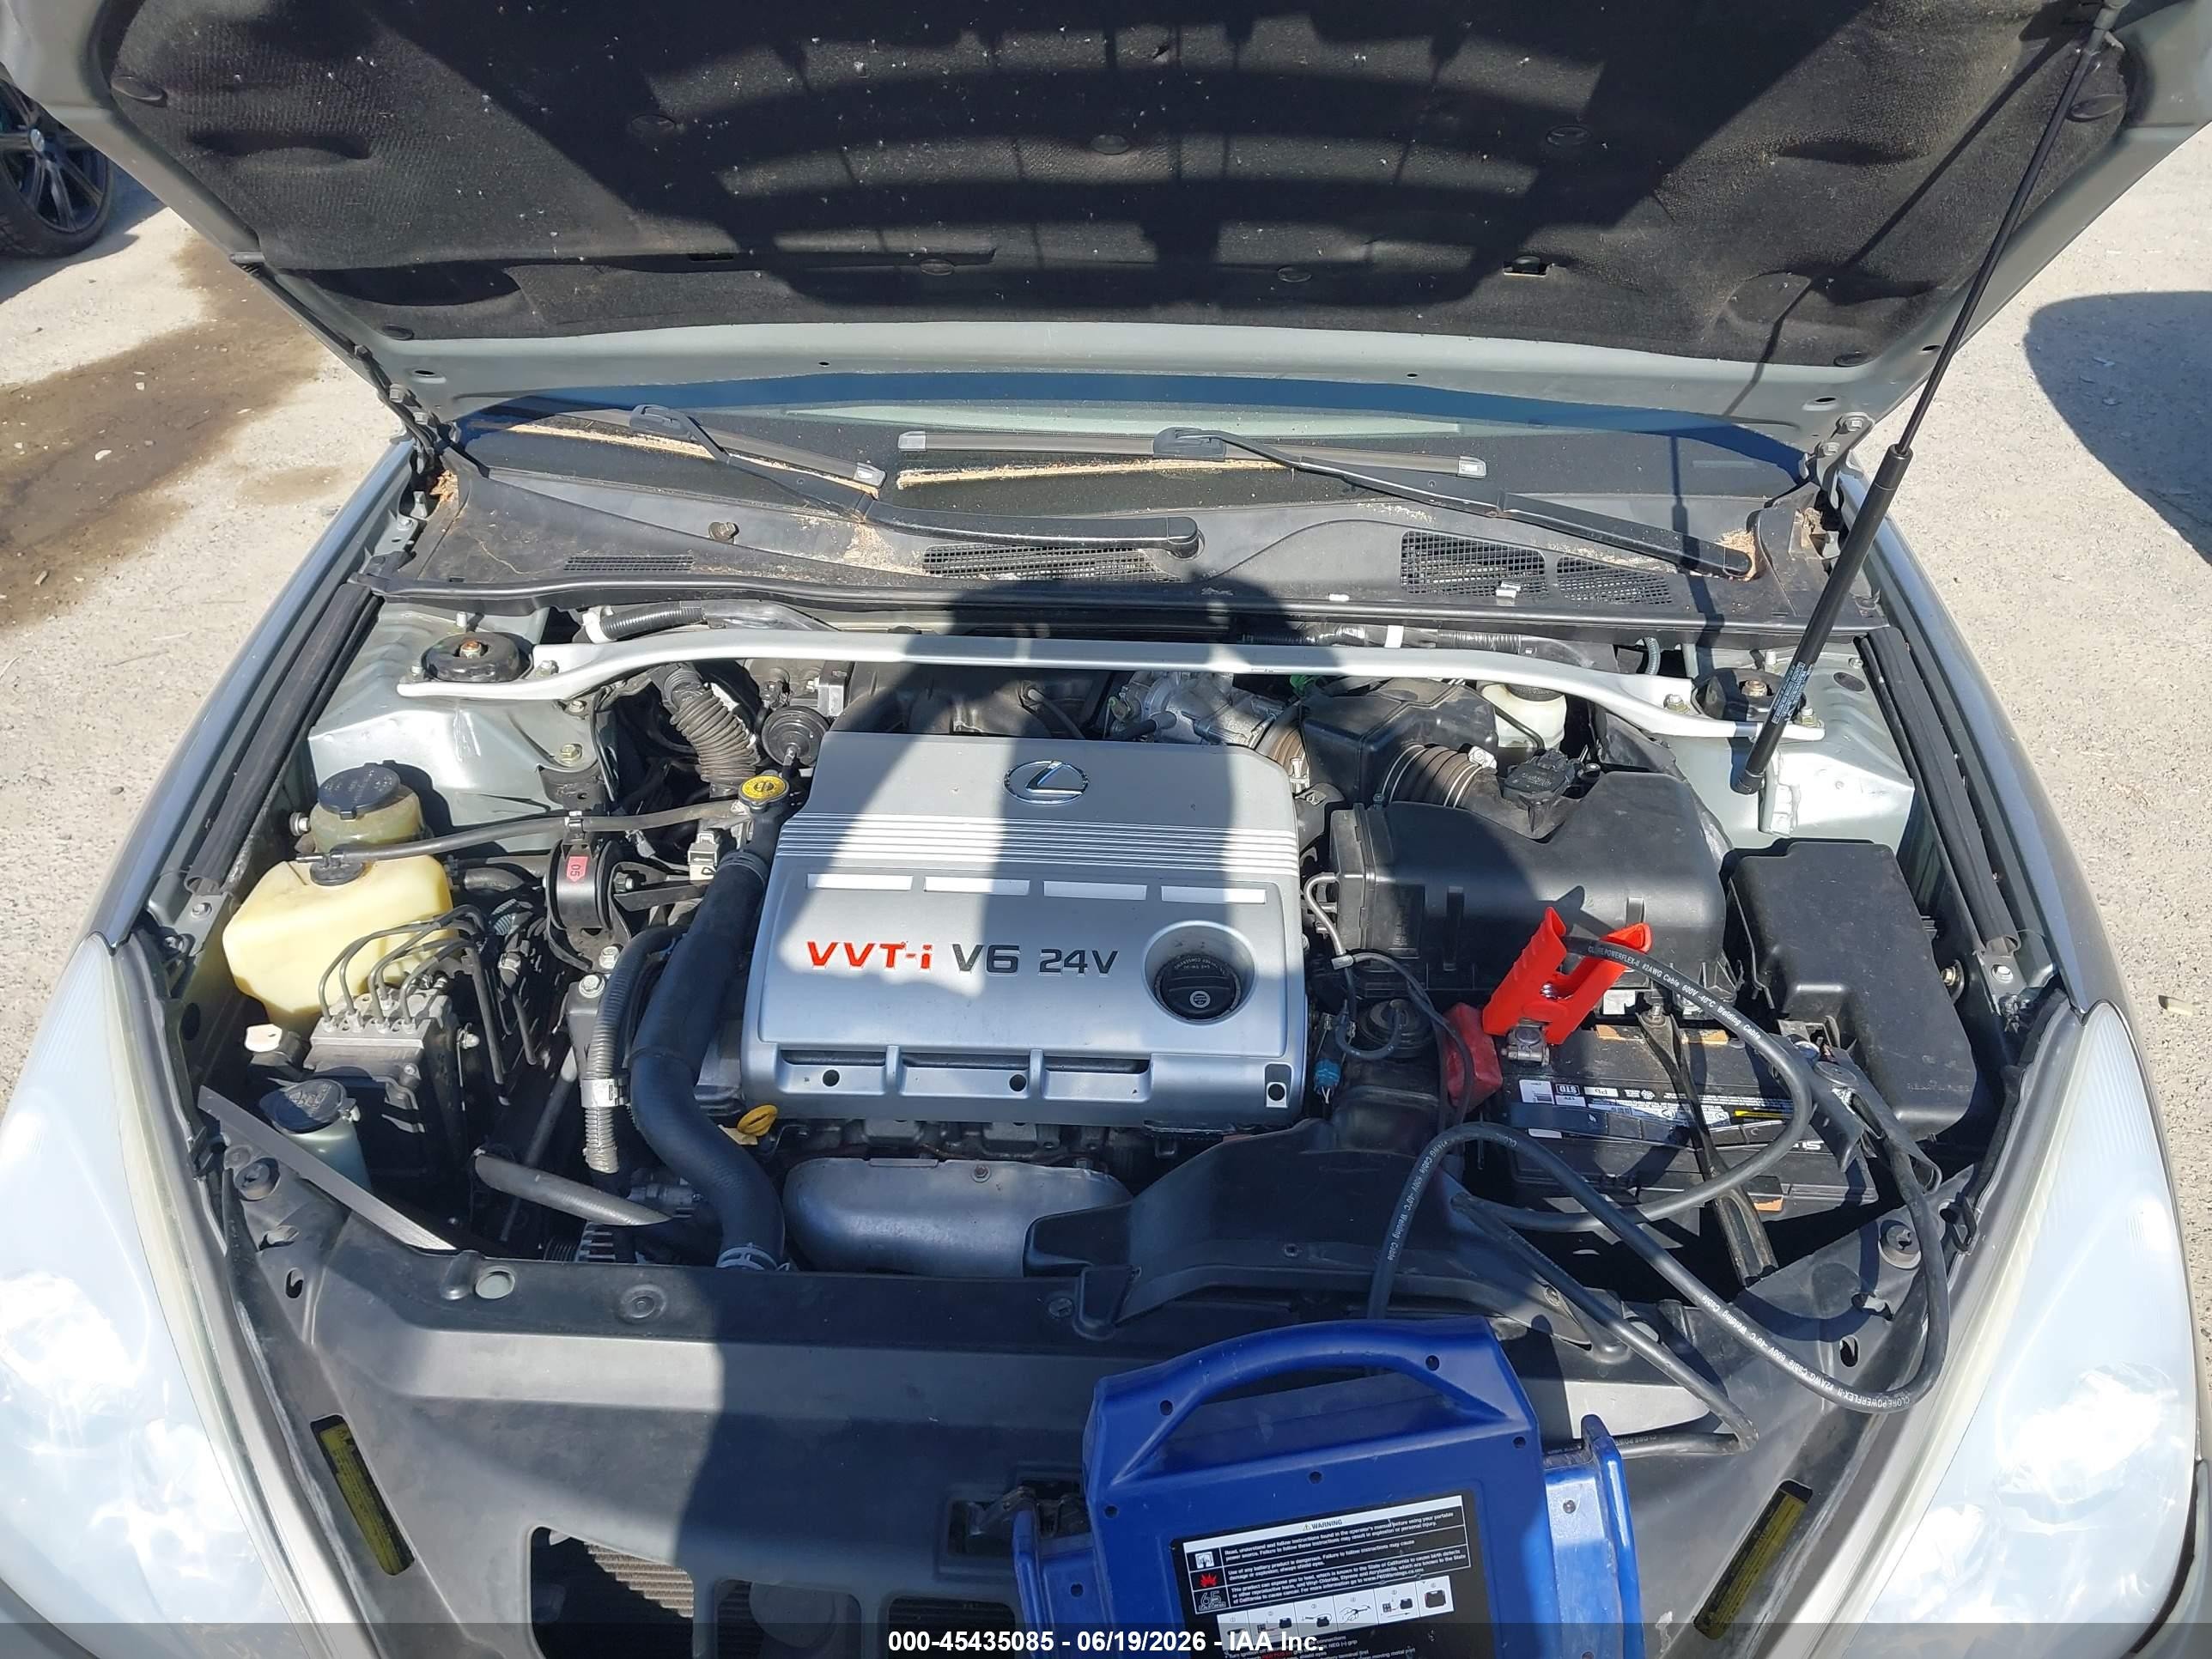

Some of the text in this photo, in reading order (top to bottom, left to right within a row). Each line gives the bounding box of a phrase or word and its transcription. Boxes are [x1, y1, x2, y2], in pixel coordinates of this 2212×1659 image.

[807, 941, 1118, 974] VVT-i V6 24V
[1642, 963, 1663, 977] #2AWG
[1662, 974, 1680, 988] Cable
[1681, 984, 1698, 996] 600V
[1717, 1006, 1742, 1027] Welding
[1743, 1024, 1761, 1040] Cable
[1391, 1213, 1408, 1239] Welding
[1387, 1242, 1399, 1261] Cable
[1702, 1294, 1721, 1312] Cable
[1722, 1310, 1748, 1335] Welding
[1768, 1346, 1786, 1362] 600V
[1789, 1359, 1808, 1375] Cable
[1291, 1534, 1319, 1544] instructions
[1433, 1511, 1453, 1520] portable
[1311, 1519, 1343, 1529] WARNING
[1311, 1537, 1340, 1546] instructions
[1371, 1528, 1394, 1537] explosion
[1271, 1560, 1290, 1569] product
[1251, 1586, 1281, 1595] reproductive
[1322, 1580, 1349, 1589] information
[1199, 1589, 1222, 1606] 65
[1316, 1635, 1346, 1644] connections
